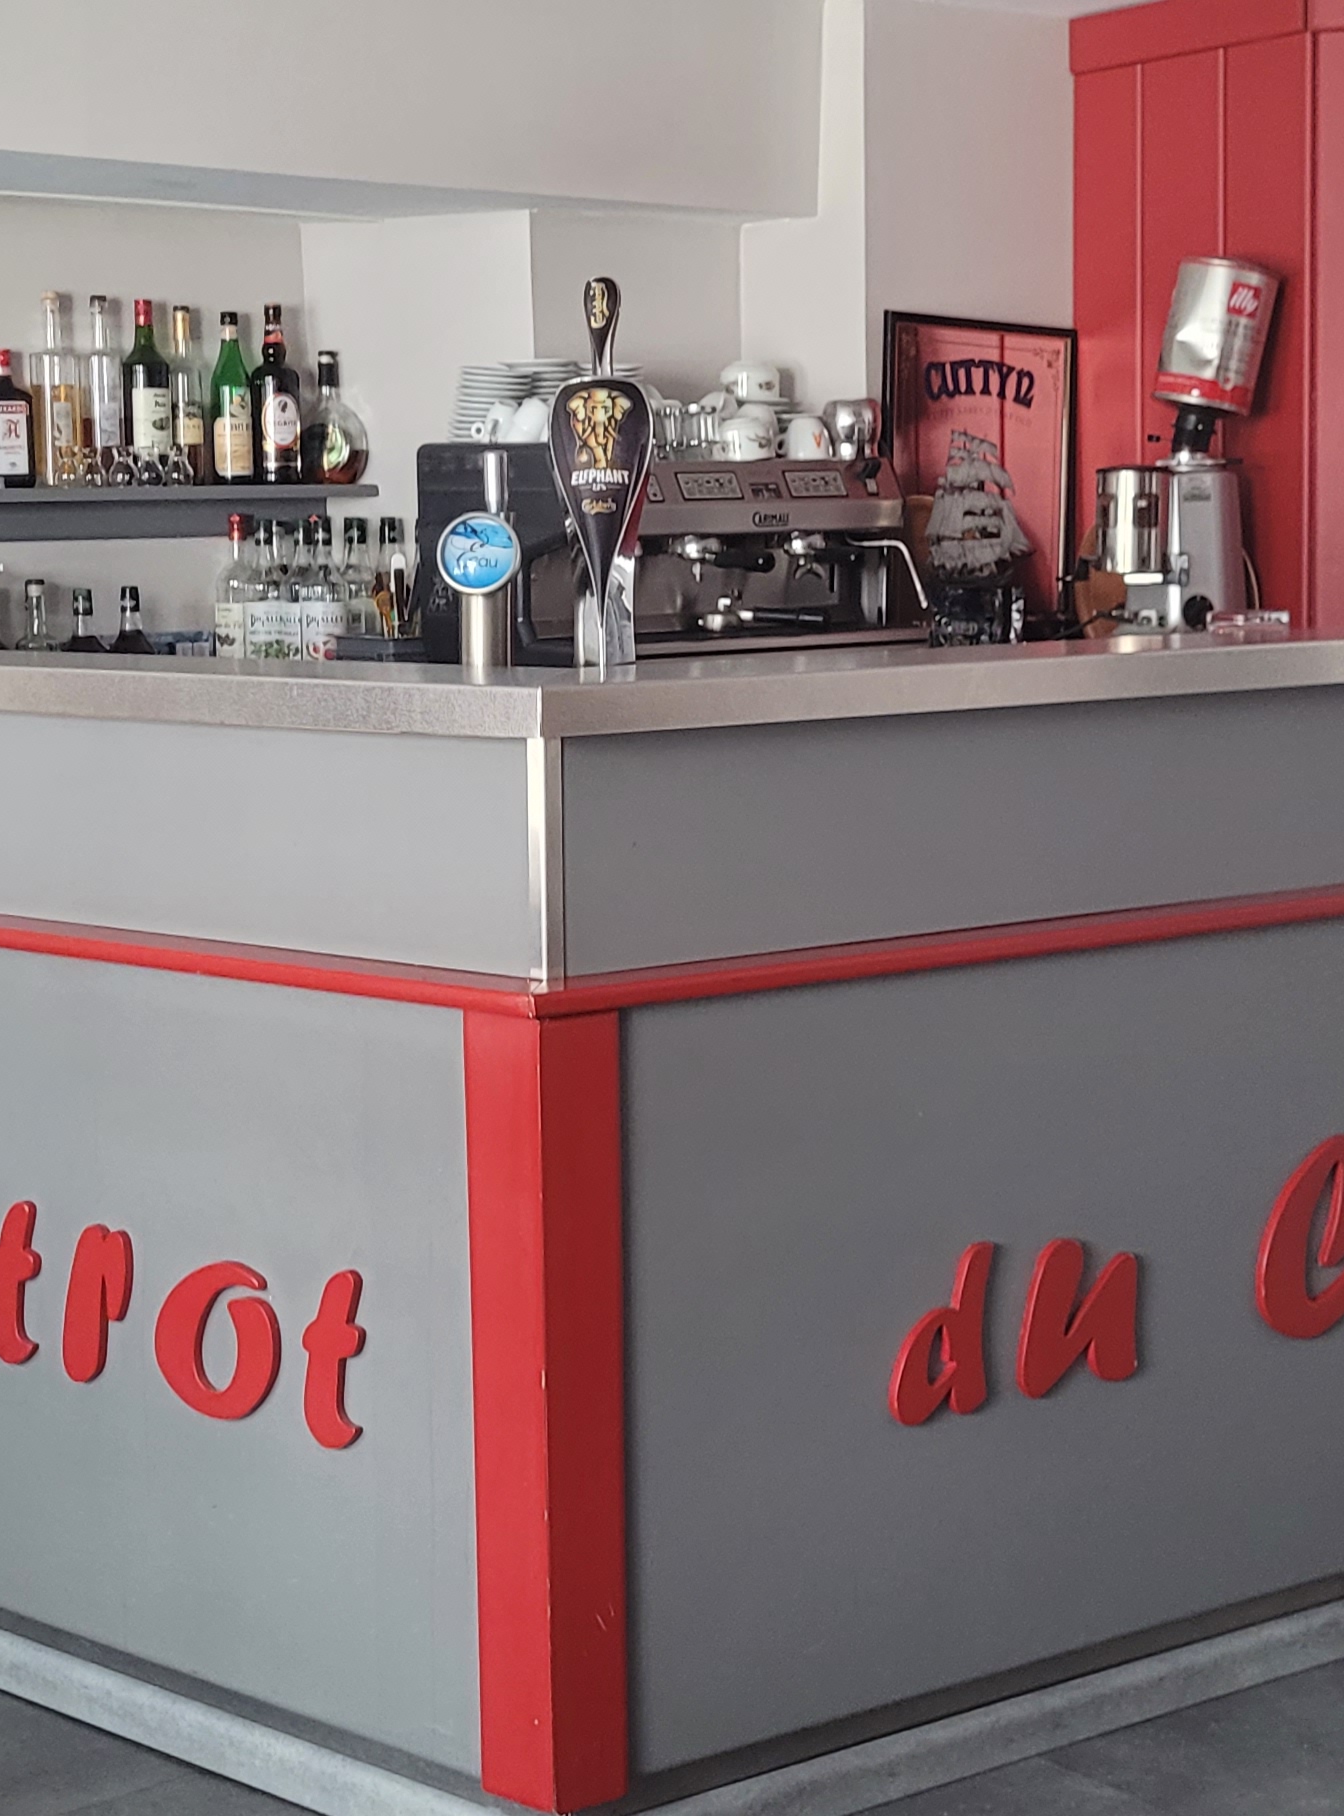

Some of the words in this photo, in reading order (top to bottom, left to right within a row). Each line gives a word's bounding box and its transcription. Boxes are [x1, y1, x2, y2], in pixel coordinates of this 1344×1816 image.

[1229, 286, 1259, 316] illy
[925, 359, 1015, 401] CUTTY
[570, 468, 630, 487] ELEPHANT
[887, 1238, 1139, 1427] du
